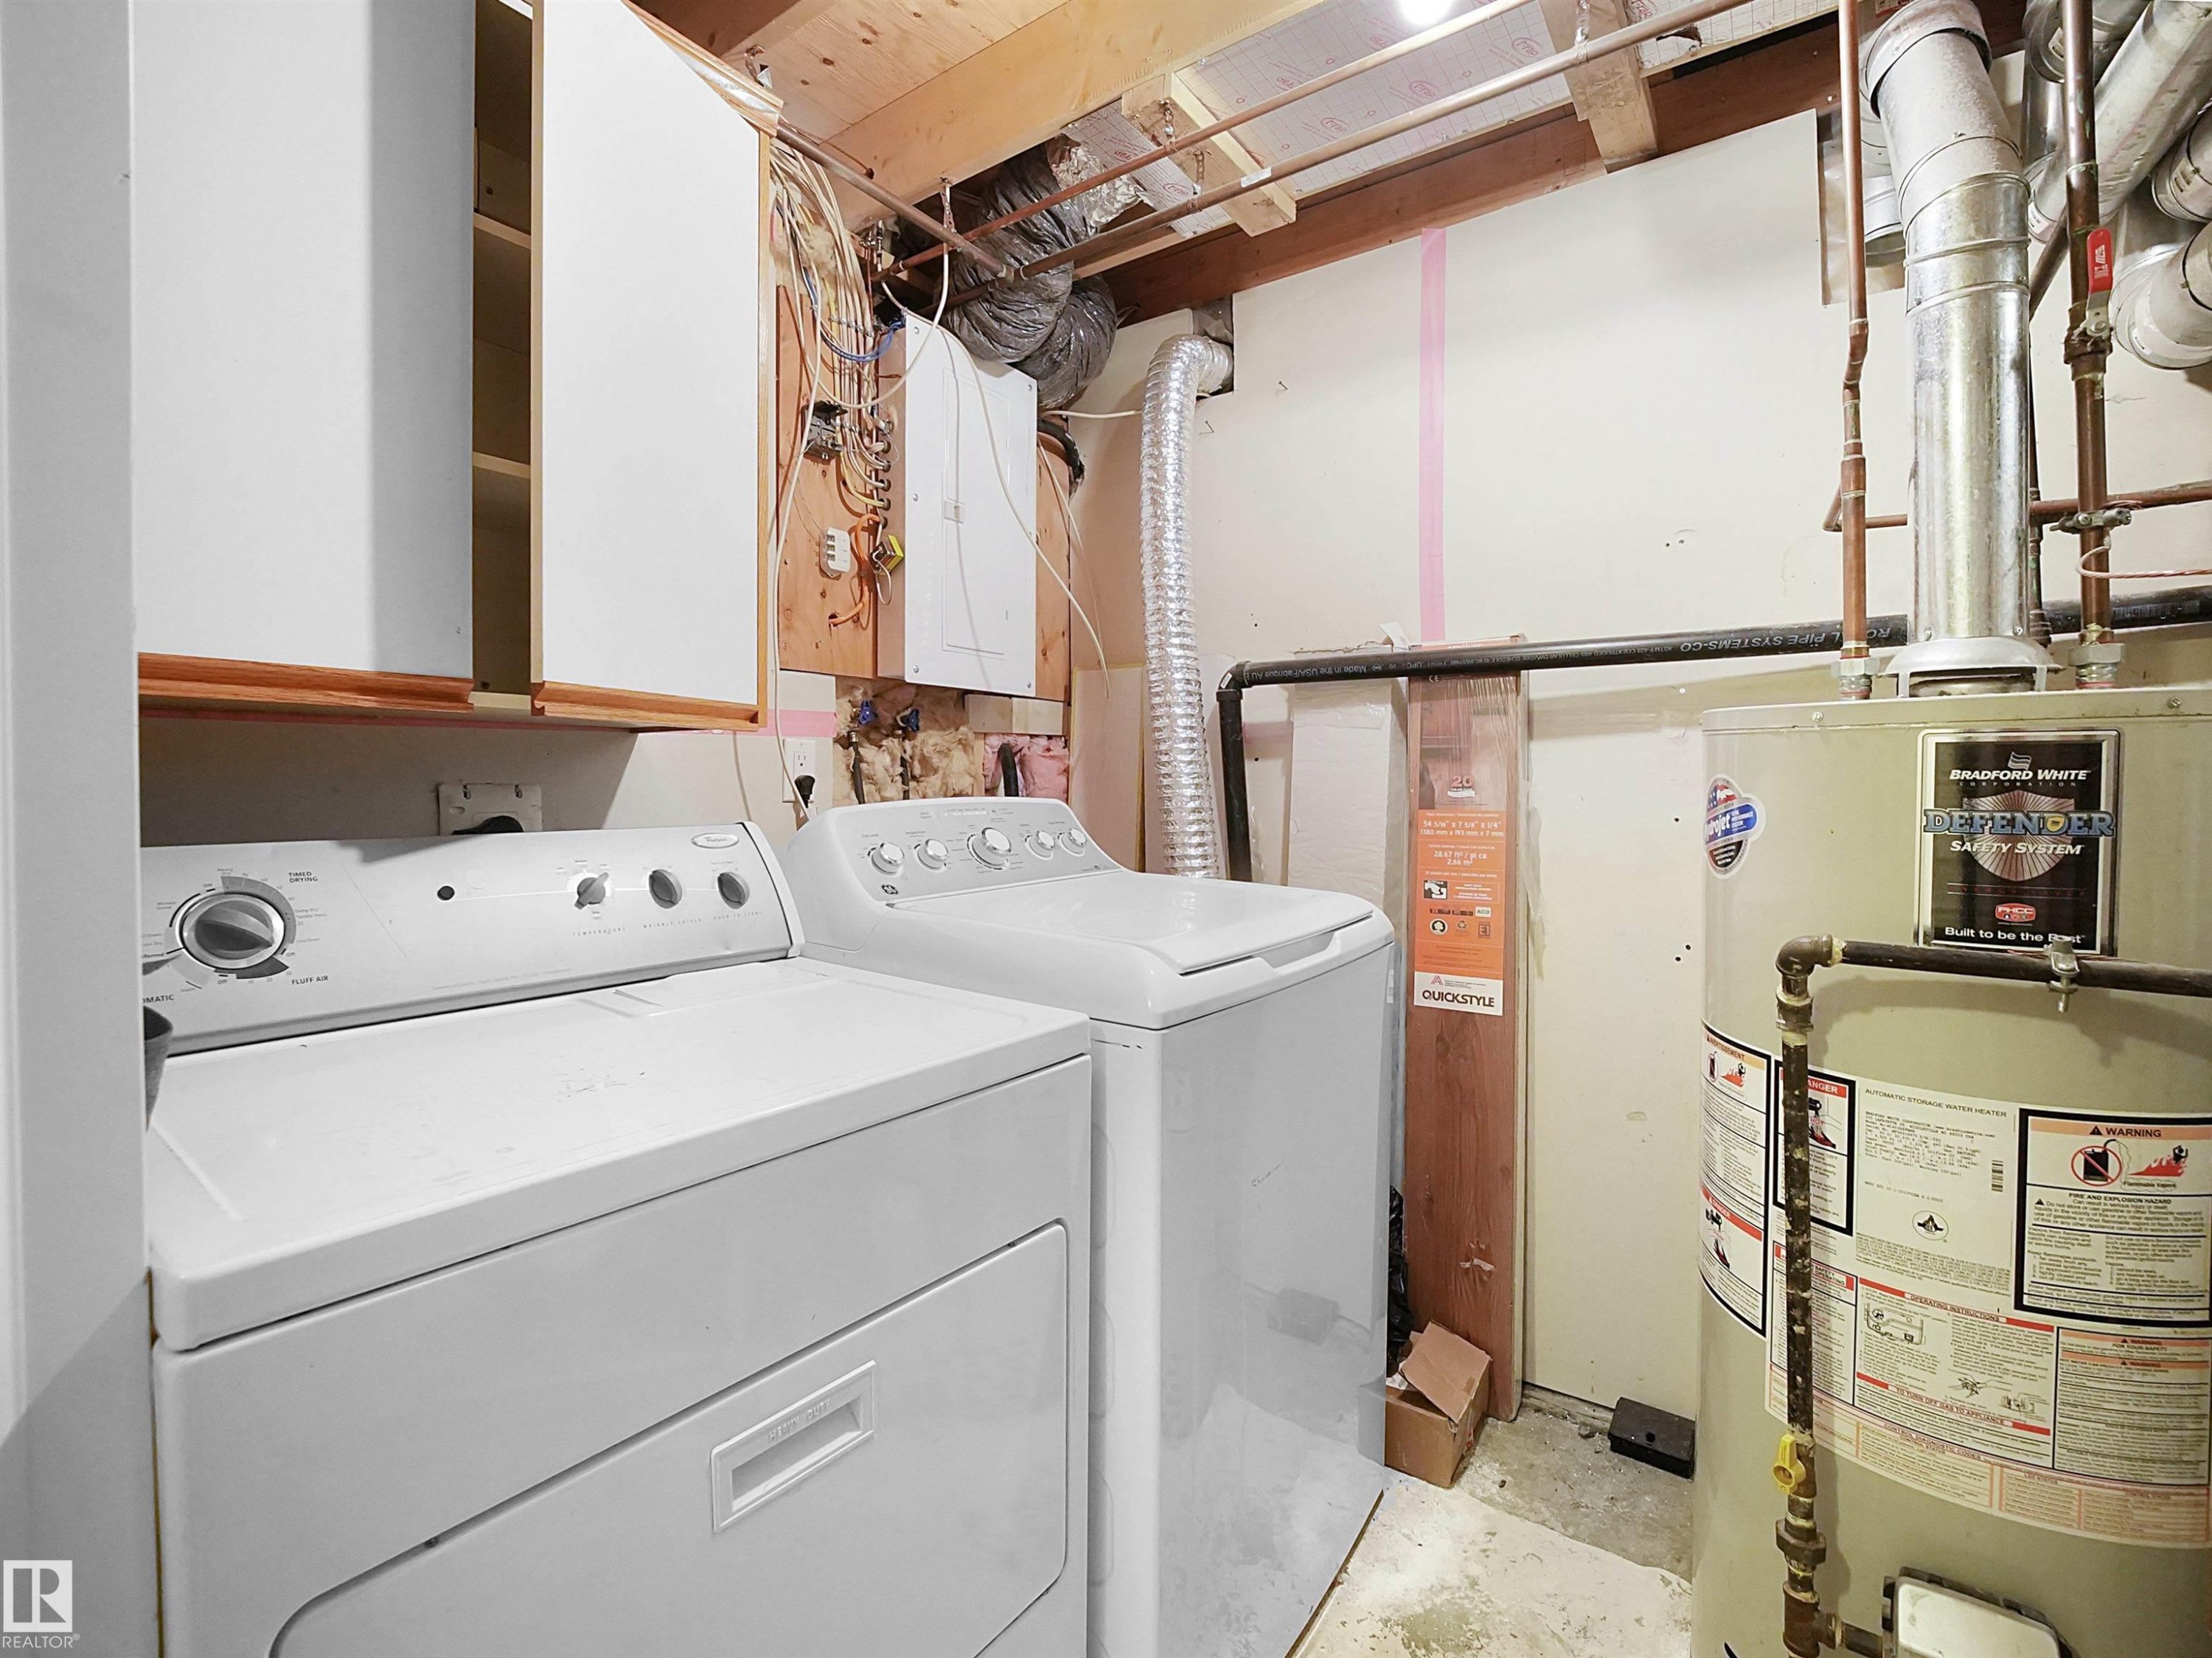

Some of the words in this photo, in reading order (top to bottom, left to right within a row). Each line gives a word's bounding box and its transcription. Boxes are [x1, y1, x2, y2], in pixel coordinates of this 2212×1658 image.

[1788, 632, 1826, 646] PIPE
[1832, 627, 1891, 643] ROL
[1680, 635, 1784, 652] SYSTEMS-CO
[1343, 665, 1367, 674] Made
[1451, 775, 1473, 788] 20
[1949, 769, 2034, 781] BRADFORD
[1923, 809, 2116, 837] DEFENDER
[1950, 840, 2011, 853] SAFETY
[2014, 842, 2083, 855] SYSTEM
[1997, 907, 2034, 915] PHCC
[1945, 927, 1975, 938] Built
[1979, 929, 1994, 938] to
[1997, 930, 2017, 940] be
[2020, 932, 2044, 942] the
[291, 977, 313, 985] FLUFF
[1422, 989, 1495, 1008] QUICKSTYLE
[1808, 1079, 1838, 1094] ANGER
[1865, 1088, 1906, 1101] AUTOMATIC
[1907, 1096, 1944, 1108] STORAGE
[1945, 1103, 1974, 1113] WATER
[1975, 1108, 2008, 1118] HEATER
[2106, 1127, 2162, 1138] WARNING
[2104, 1195, 2143, 1203] EXPLOSION
[1910, 1294, 1948, 1311] OPERATING
[1949, 1304, 2000, 1322] INSTRUCTIONS
[1896, 1387, 1905, 1396] TO
[1907, 1390, 1924, 1402] TURN
[1940, 1402, 1954, 1412] GAS
[1955, 1406, 1965, 1414] TO
[1966, 1410, 2004, 1425] APPLIANCE
[1884, 1423, 1913, 1438] CONTROL
[1916, 1432, 1955, 1452] DIAGNOSTIC
